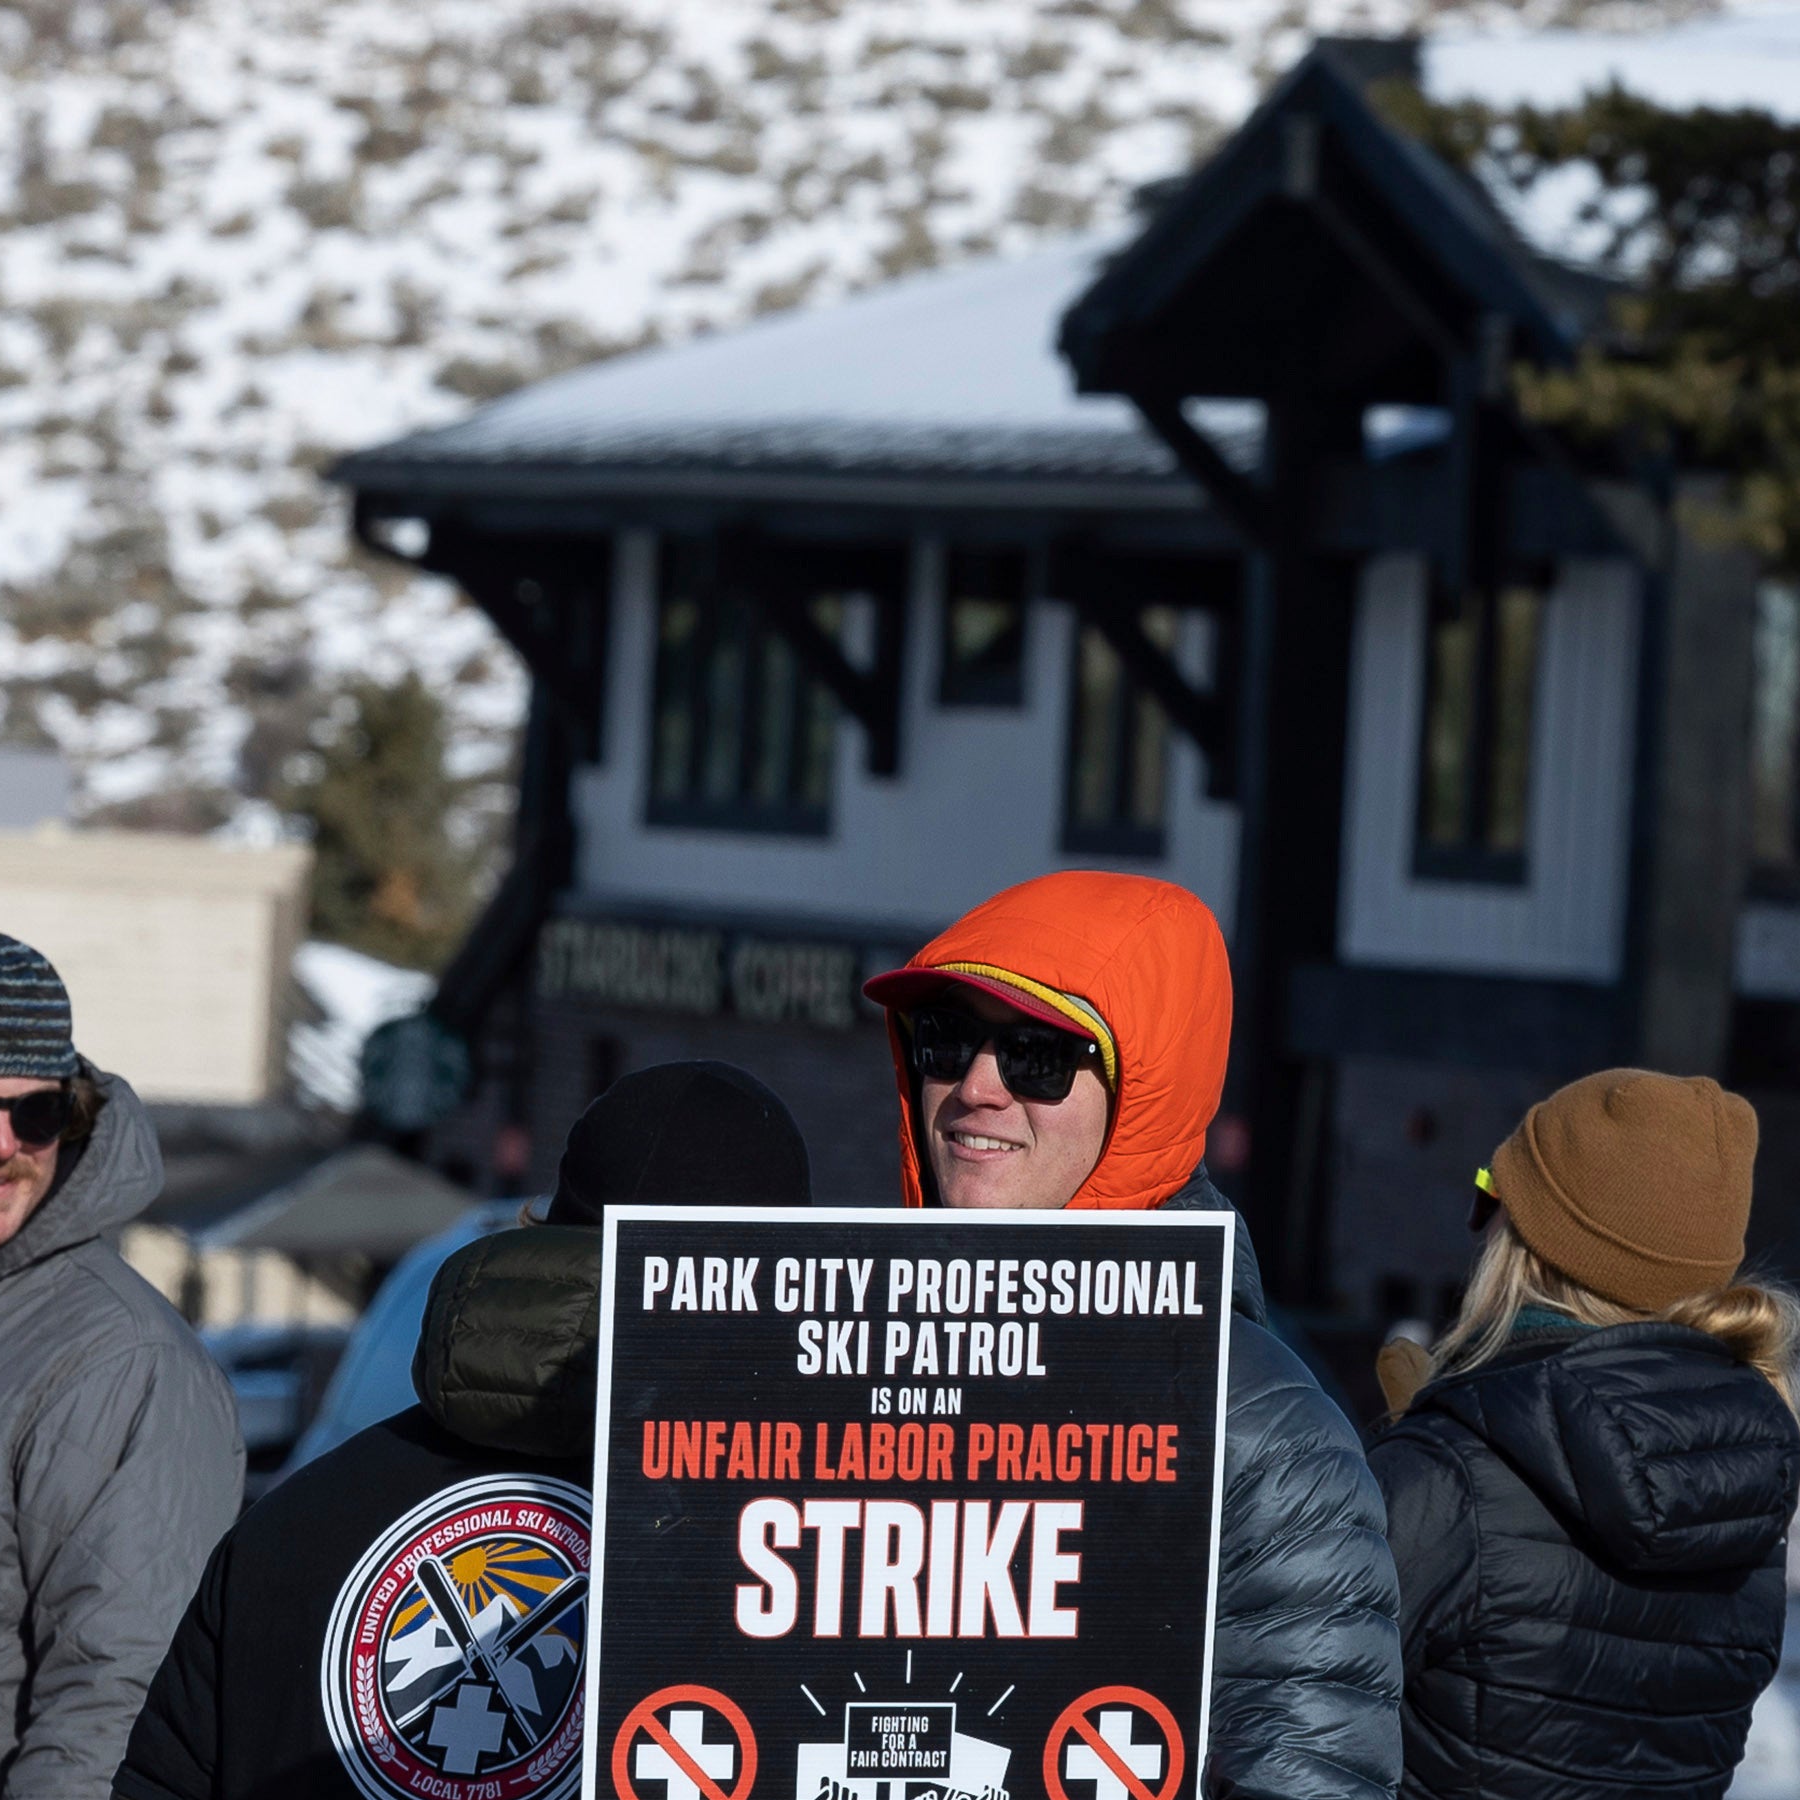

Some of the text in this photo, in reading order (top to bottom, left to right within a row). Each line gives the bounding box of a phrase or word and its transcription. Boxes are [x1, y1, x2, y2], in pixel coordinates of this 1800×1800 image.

[642, 1255, 1204, 1316] PARK CITY PROFESSIONAL
[796, 1320, 1046, 1377] SKI PATROL
[871, 1387, 962, 1416] IS ON AN
[642, 1420, 1179, 1483] UNFAIR LABOR PRACTICE
[360, 1577, 398, 1645] UNITED
[394, 1509, 512, 1580] PROFESSIONAL
[515, 1509, 544, 1530] SKI
[735, 1496, 1085, 1640] STRIKE
[871, 1716, 929, 1733] FIGHTING
[881, 1733, 917, 1750] FOR A
[850, 1750, 947, 1768] FAIR CONTRACT
[410, 1770, 503, 1800] LOCAL 7781
